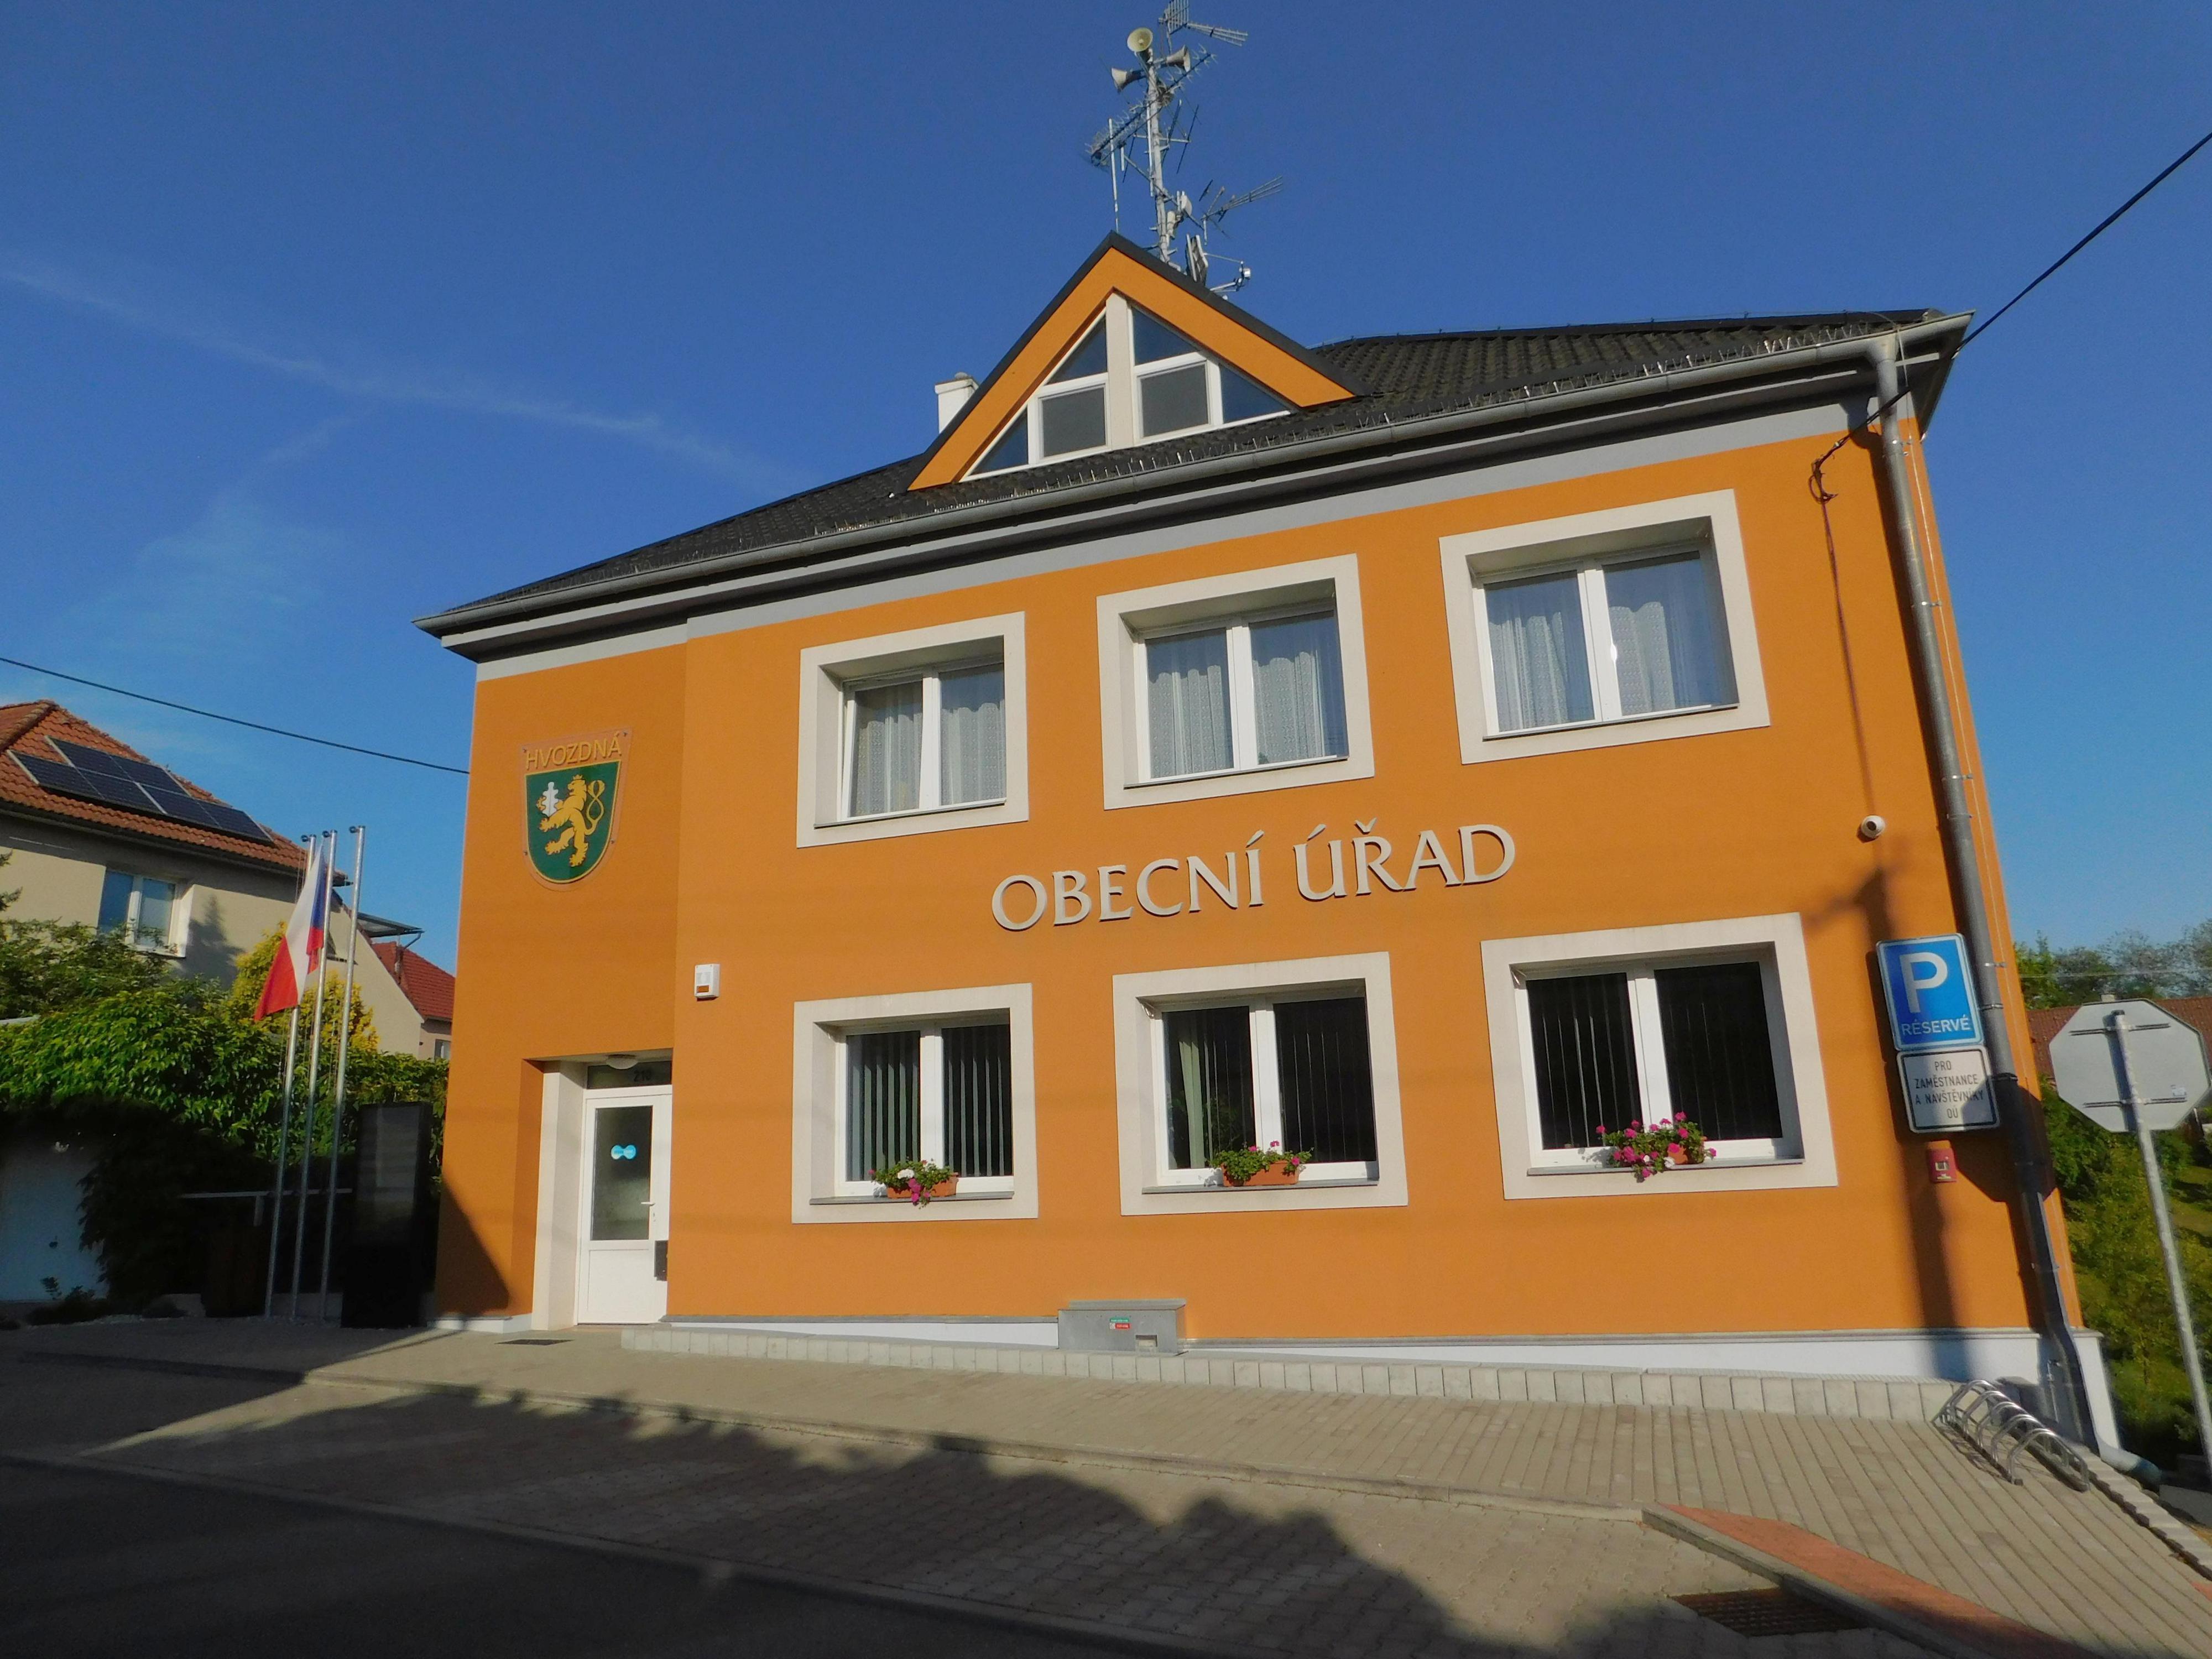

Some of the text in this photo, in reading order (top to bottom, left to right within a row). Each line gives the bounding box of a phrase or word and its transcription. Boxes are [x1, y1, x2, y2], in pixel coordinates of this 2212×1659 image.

[525, 731, 622, 770] HVOZDNÁ
[991, 818, 1515, 932] OBECNÍ ÚŘAD
[1899, 952, 1948, 1014] P
[1901, 1014, 1971, 1036] RÉSERVÉ
[1934, 1060, 1952, 1071] PRO
[1914, 1074, 1978, 1089] ZAMĚSTNANCE
[1915, 1088, 1984, 1105] A NAVŠTĚVNÍKY
